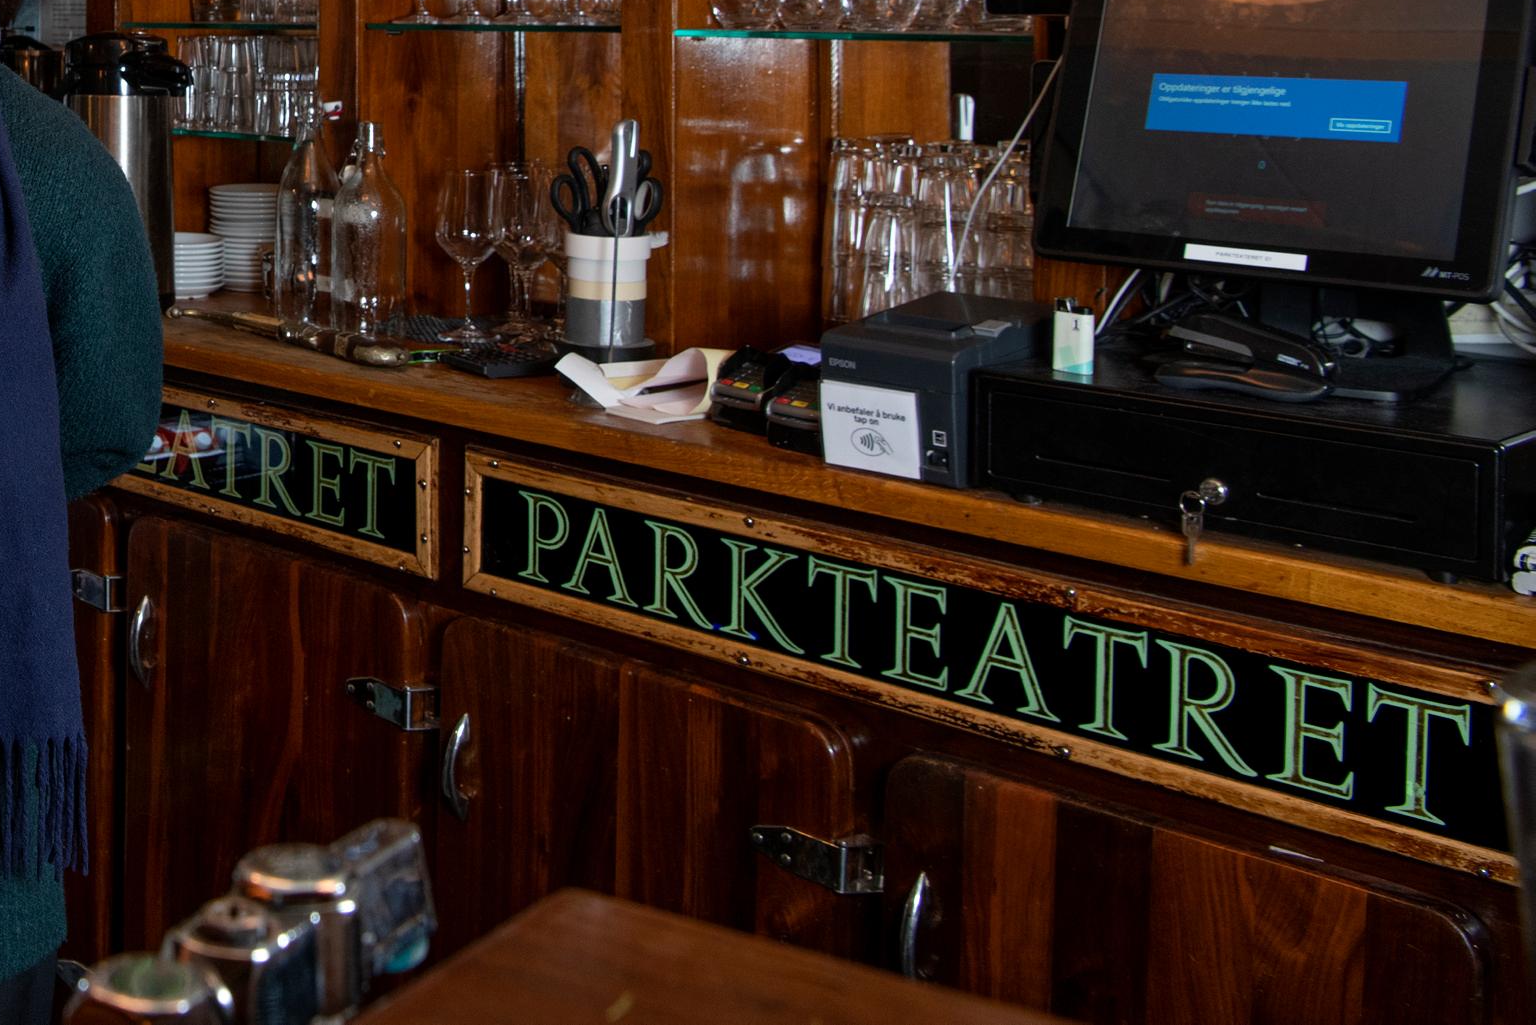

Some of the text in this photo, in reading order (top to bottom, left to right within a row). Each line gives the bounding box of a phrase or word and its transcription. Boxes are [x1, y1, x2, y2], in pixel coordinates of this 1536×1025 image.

[828, 357, 857, 370] EPSON
[827, 402, 907, 423] Vi anbefaler å bruke
[853, 416, 868, 427] tap
[133, 409, 396, 539] ATRET
[516, 488, 1472, 827] PARKTEATRET
